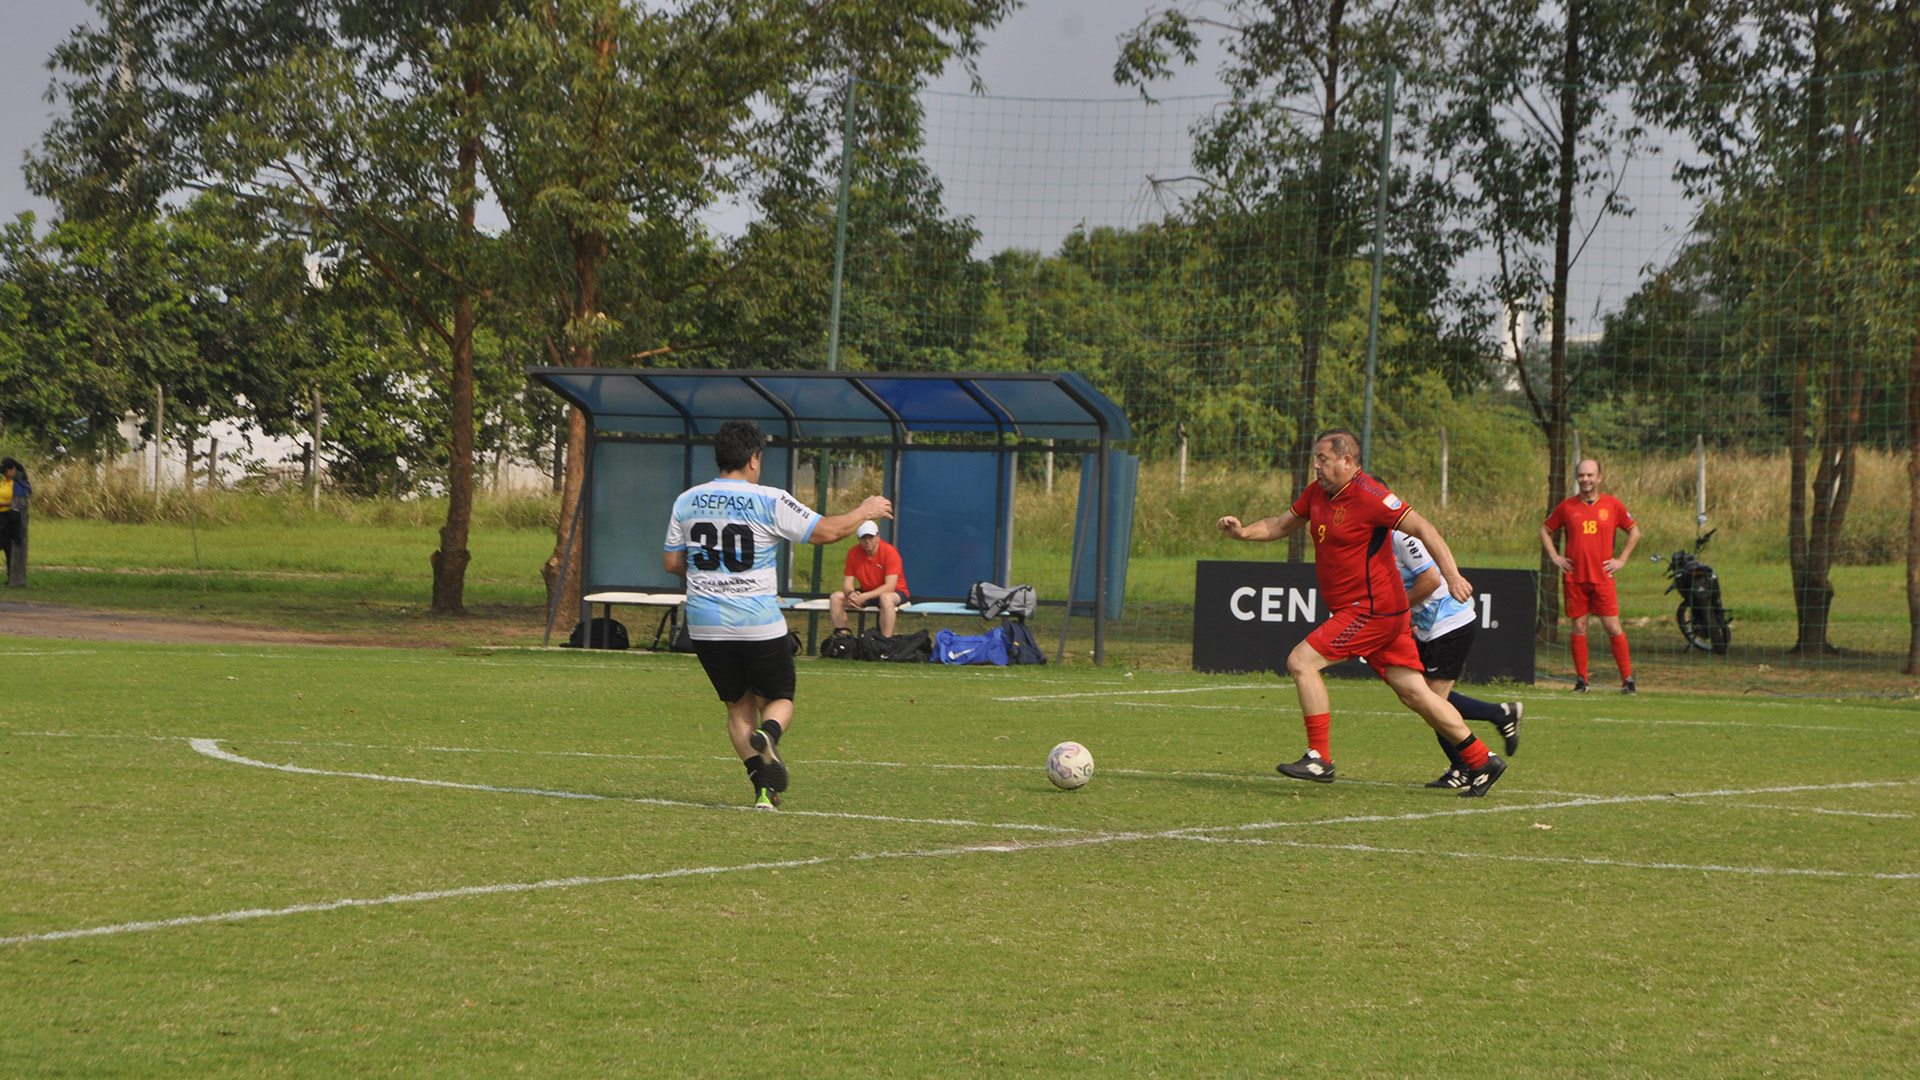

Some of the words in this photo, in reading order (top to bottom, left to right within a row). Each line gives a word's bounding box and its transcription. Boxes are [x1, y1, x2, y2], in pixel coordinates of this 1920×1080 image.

[692, 494, 754, 511] ASEPASA
[1317, 524, 1326, 544] 9
[1582, 520, 1598, 534] 18
[690, 522, 755, 573] 30
[1402, 535, 1423, 559] 1987
